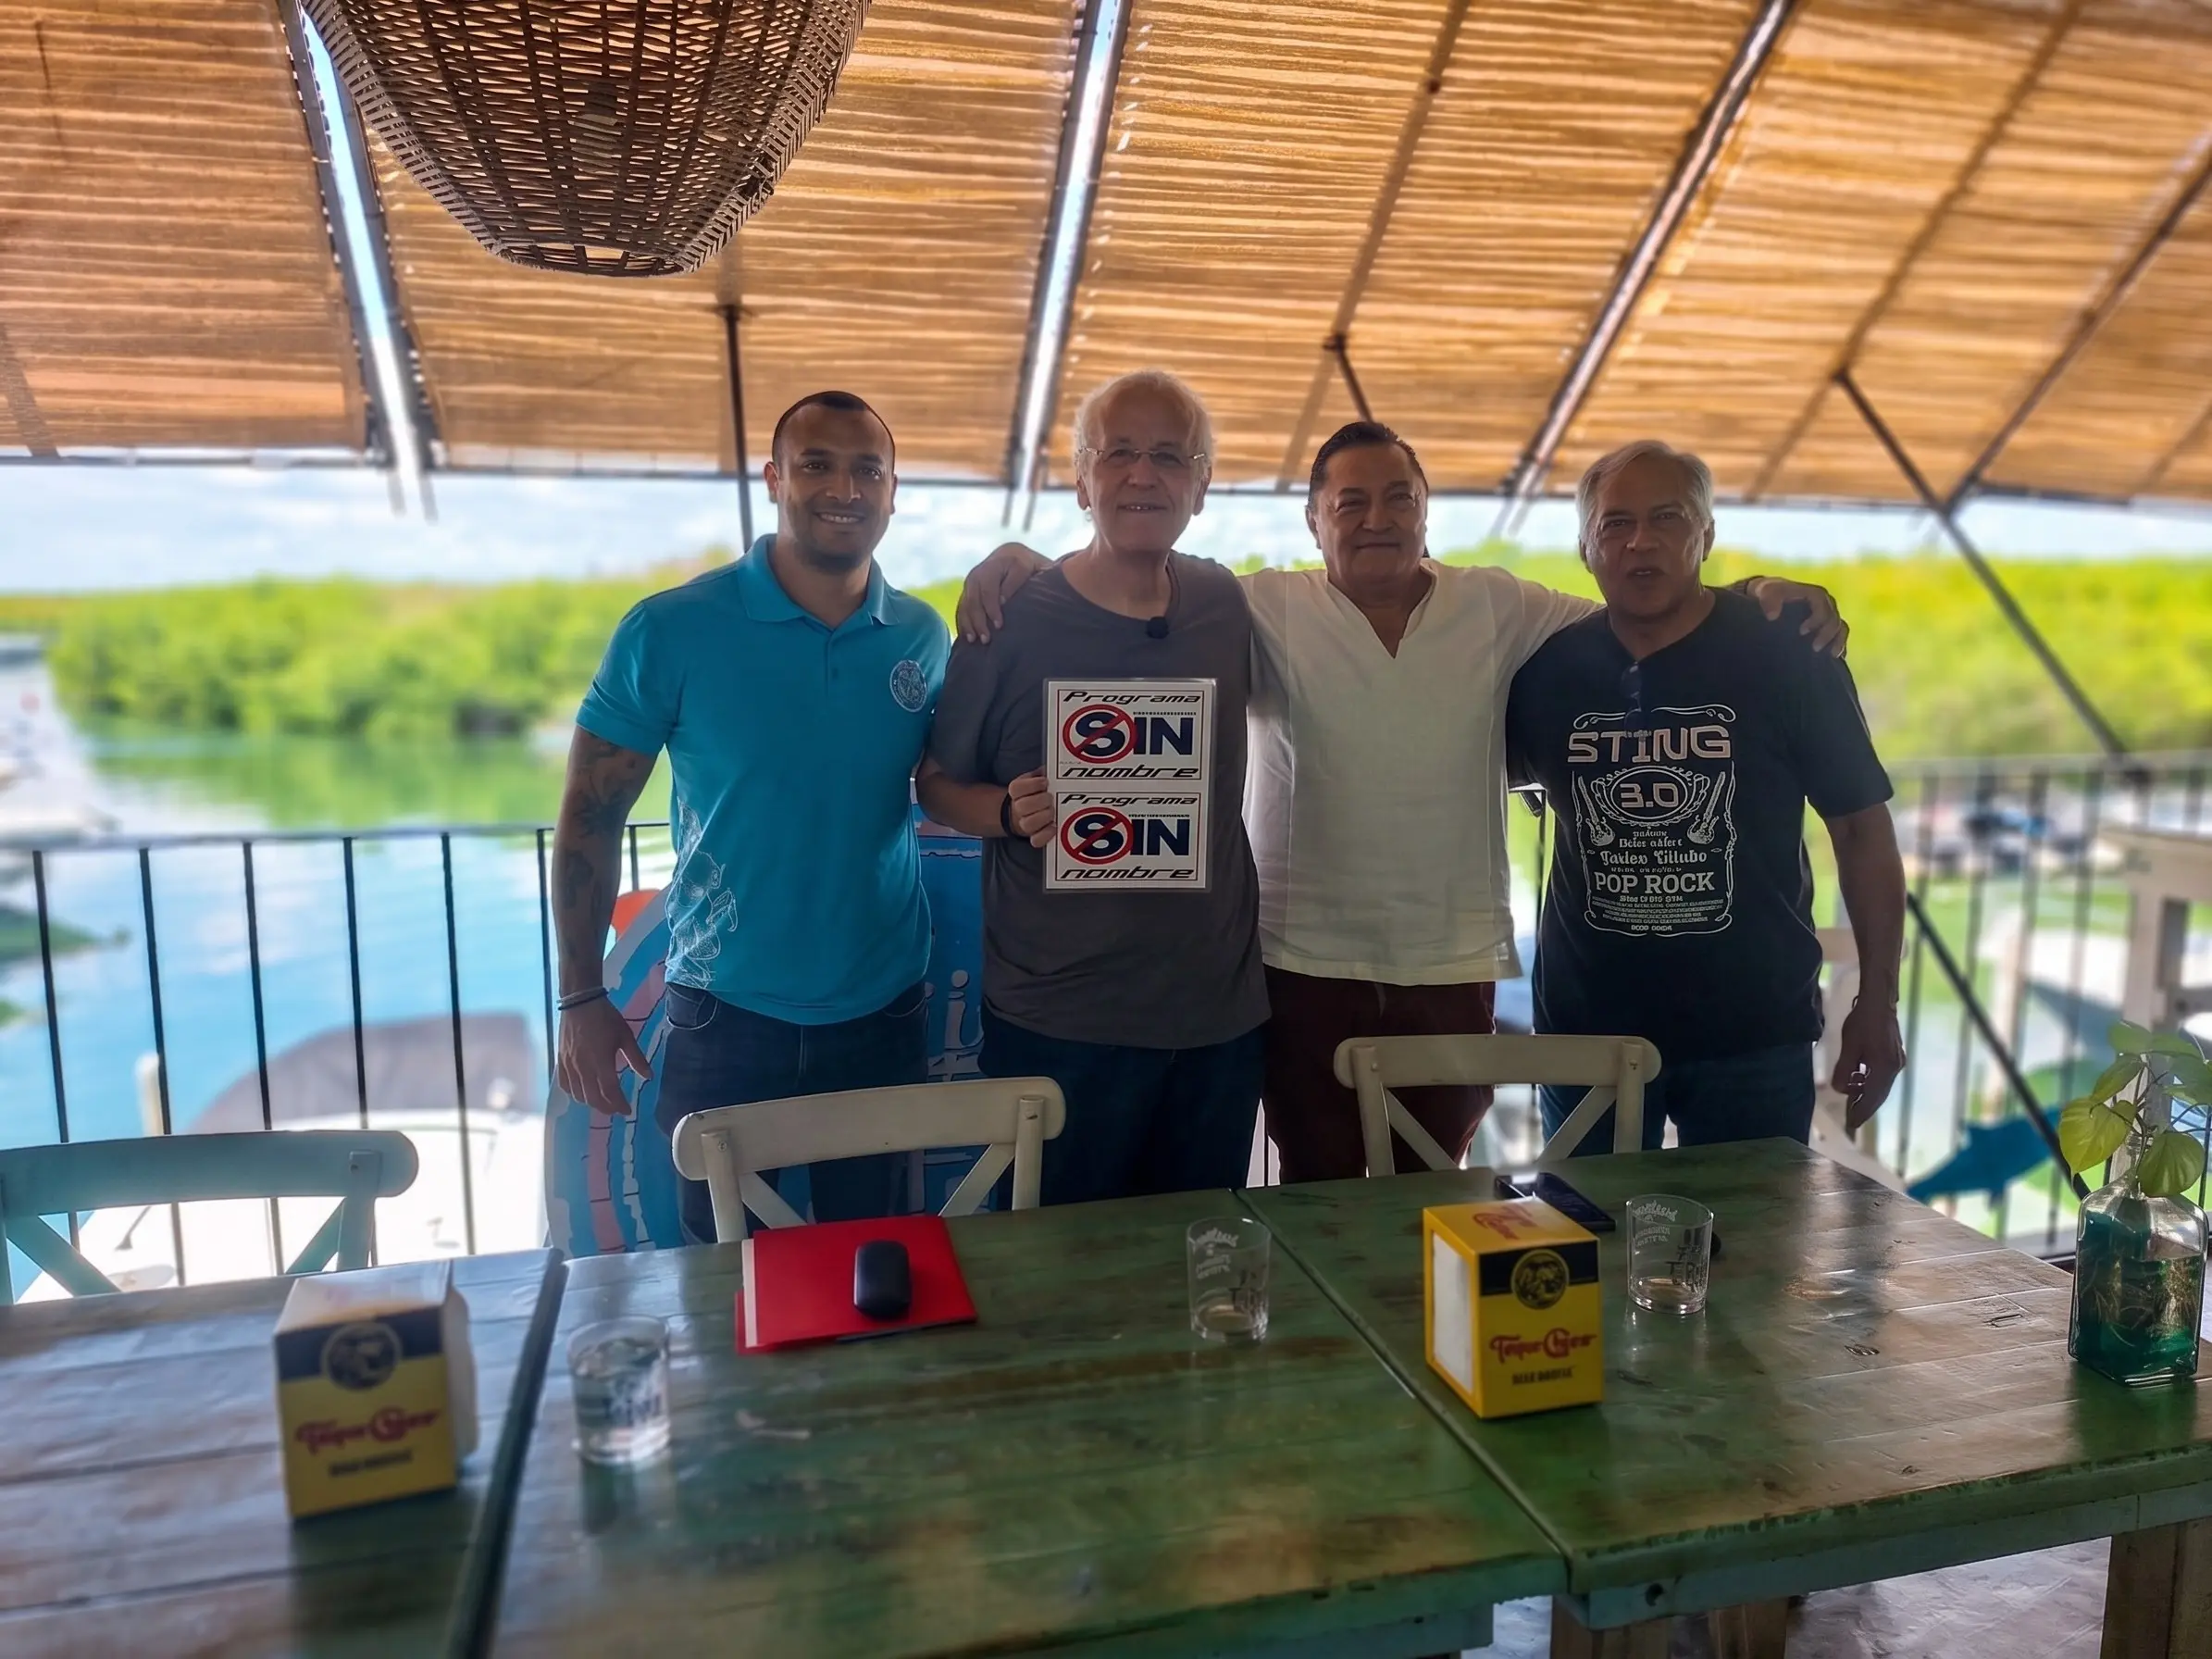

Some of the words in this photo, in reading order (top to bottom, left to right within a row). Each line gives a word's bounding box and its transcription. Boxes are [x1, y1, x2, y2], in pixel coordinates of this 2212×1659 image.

[1063, 691, 1201, 705] Programa
[1075, 711, 1194, 756] SIN
[1567, 725, 1731, 763] STING
[1062, 764, 1199, 778] nombre
[1061, 793, 1198, 807] Programa
[1620, 782, 1680, 808] 3.0
[1074, 814, 1191, 857] SIN
[1061, 866, 1195, 879] nombre
[1594, 871, 1638, 894] POP
[1644, 871, 1715, 894] ROCK
